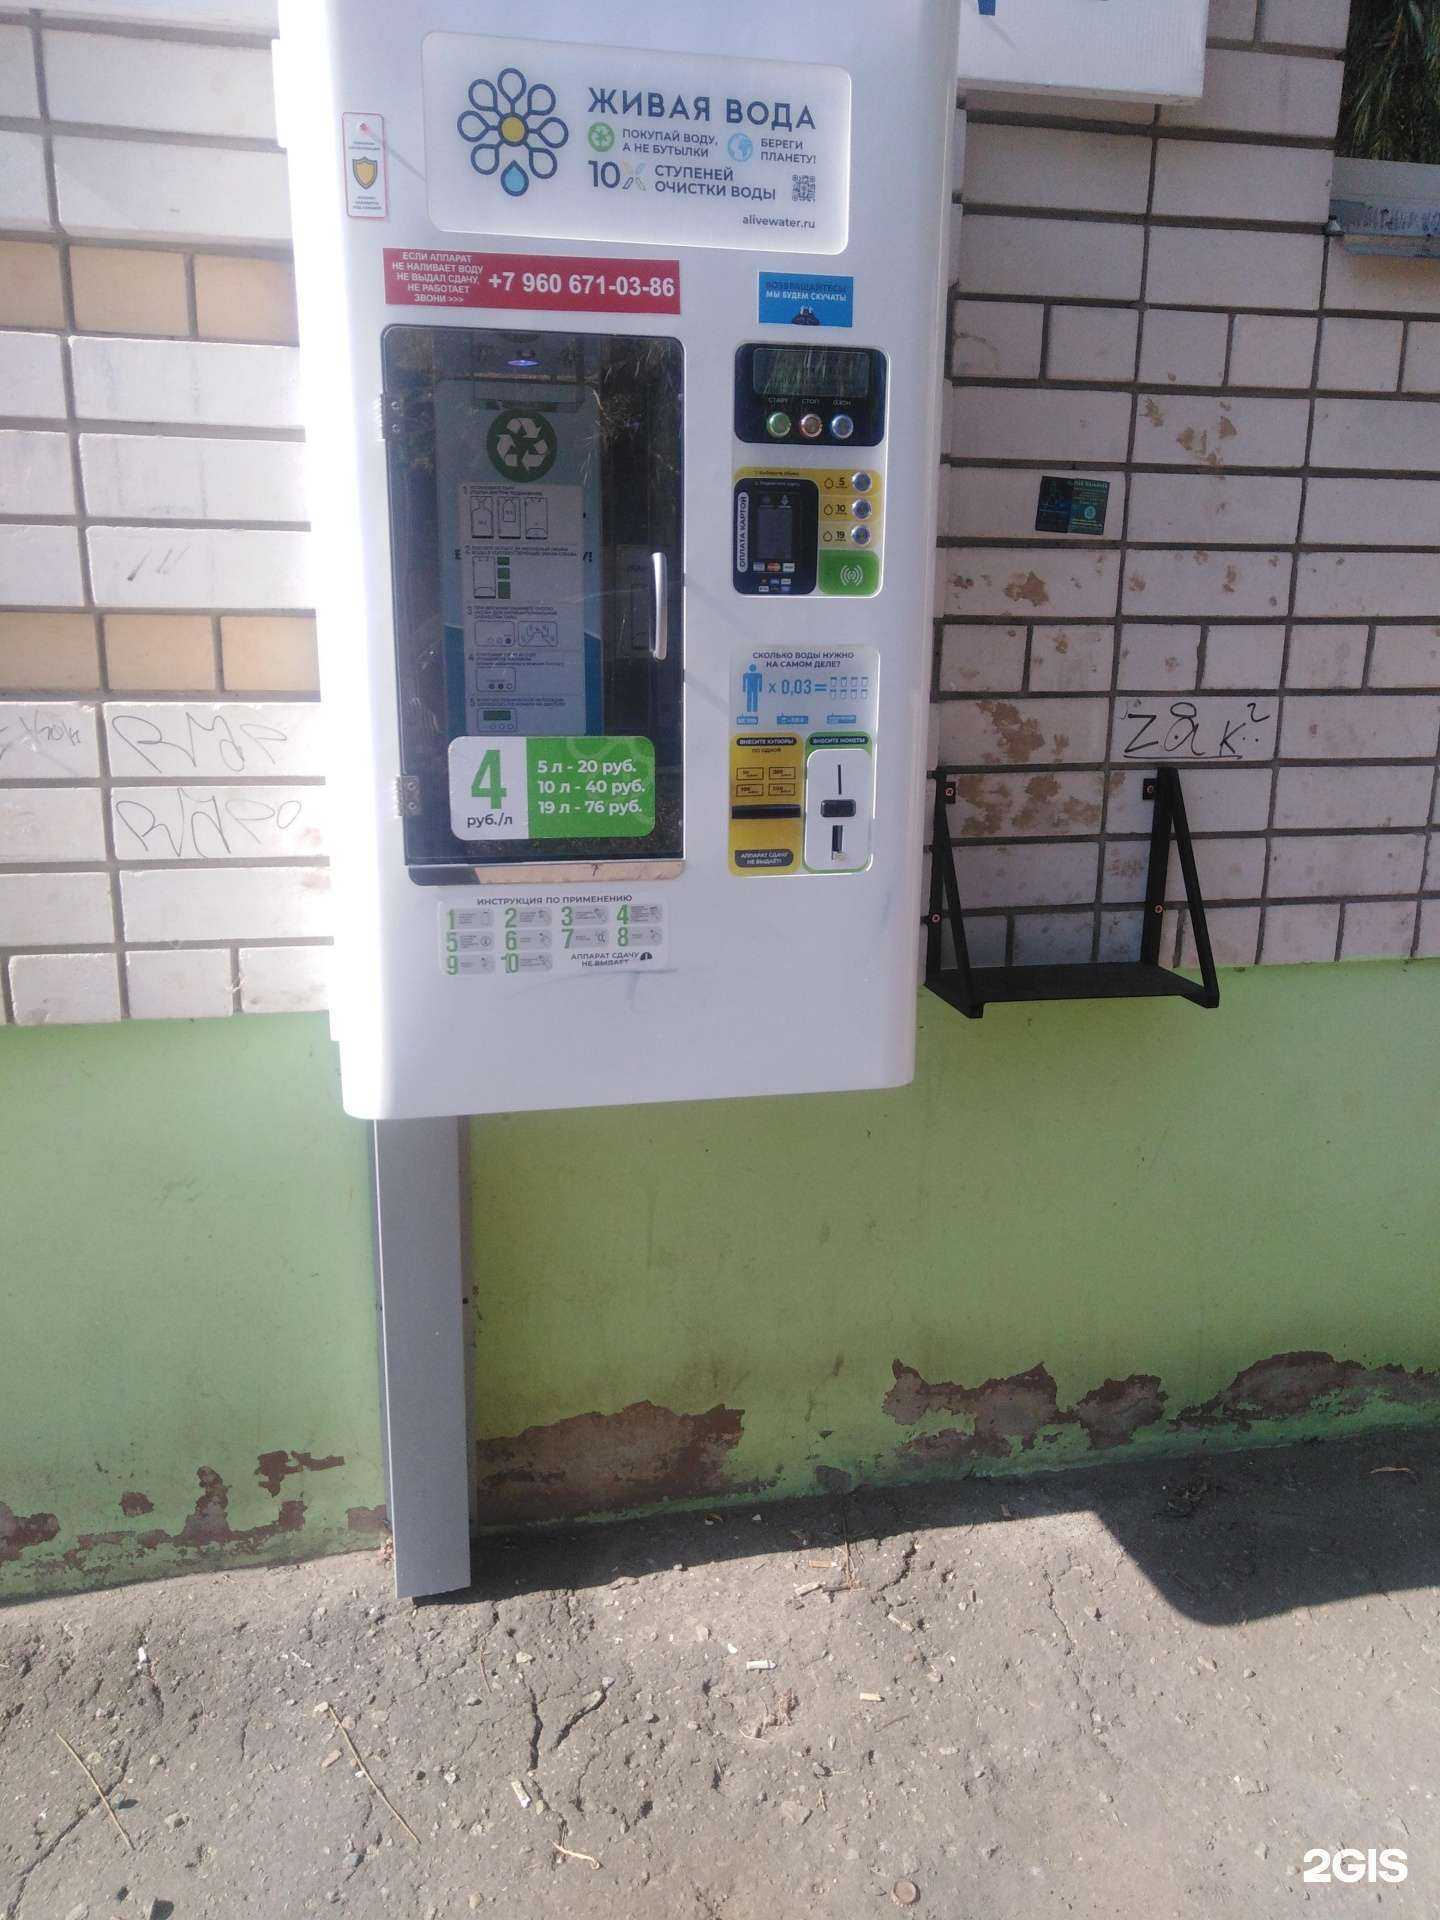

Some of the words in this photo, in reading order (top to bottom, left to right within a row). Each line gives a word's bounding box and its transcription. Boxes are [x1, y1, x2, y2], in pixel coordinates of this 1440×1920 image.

[587, 87, 711, 122] ЖИВАЯ
[725, 98, 817, 132] ВОДА
[622, 127, 681, 143] ПОКУПАЙ
[683, 132, 719, 146] ВОДУ,
[760, 137, 804, 150] БЕРЕГИ
[622, 142, 631, 153] А
[633, 142, 650, 154] НЕ
[652, 144, 709, 158] БУТЫЛКИ
[760, 152, 817, 165] ПЛАНЕТУ!
[588, 160, 621, 189] 10
[654, 164, 734, 182] СТУПЕНЕЙ
[654, 181, 727, 197] ОЧИСТКИ
[731, 186, 777, 201] ВОДЫ
[742, 214, 816, 230] alivewater.ru
[402, 251, 428, 261] ЕСЛИ
[430, 253, 473, 263] АППАРАТ
[392, 262, 406, 271] НЕ
[406, 263, 456, 273] НАЛИВАЕТ
[458, 265, 484, 275] ВОДУ
[396, 272, 411, 281] НЕ
[411, 273, 447, 283] ВЫДАЛ
[488, 271, 516, 291] +7
[522, 272, 562, 293] 960
[568, 274, 676, 297] 671-03-86
[407, 283, 420, 292] НЕ
[422, 284, 470, 294] РАБОТАЕТ
[765, 290, 780, 299] МЫ
[782, 291, 809, 300] БУДЕМ
[414, 293, 447, 303] ЗВОНИ
[839, 477, 846, 486] 5
[836, 504, 846, 513] 10
[836, 530, 846, 539] 19
[752, 651, 793, 660] СКОЛЬКО
[794, 652, 821, 661] ВОДЫ
[822, 651, 855, 660] НУЖНО
[766, 660, 779, 668] НА
[780, 660, 813, 669] САМОМ
[813, 660, 841, 669] ДЕЛЕ?
[781, 679, 812, 696] 0,03
[537, 759, 548, 774] 5
[551, 762, 563, 774] л
[577, 759, 599, 774] 20
[602, 758, 637, 776] руб.
[470, 749, 508, 810] 4
[537, 780, 556, 794] 10
[559, 782, 571, 793] л
[585, 780, 608, 794] 40
[611, 779, 646, 796] руб.
[538, 801, 556, 814] 19
[559, 803, 570, 814] л
[585, 800, 606, 814] 76
[608, 799, 643, 816] руб.
[466, 812, 513, 828] руб./л
[476, 896, 543, 906] ИНСТРУКЦИЯ
[545, 896, 561, 904] ПО
[562, 894, 633, 904] ПРИМЕНЕНИЮ
[447, 909, 456, 930] 1
[504, 907, 518, 929] 2
[560, 905, 573, 927] 3
[616, 903, 630, 926] 4
[446, 931, 458, 953] 5
[505, 930, 518, 951] 6
[561, 928, 575, 949] 7
[617, 926, 629, 947] 8
[570, 952, 610, 961] АППАРАТ
[612, 951, 640, 960] СДАЧУ
[447, 954, 459, 976] 9
